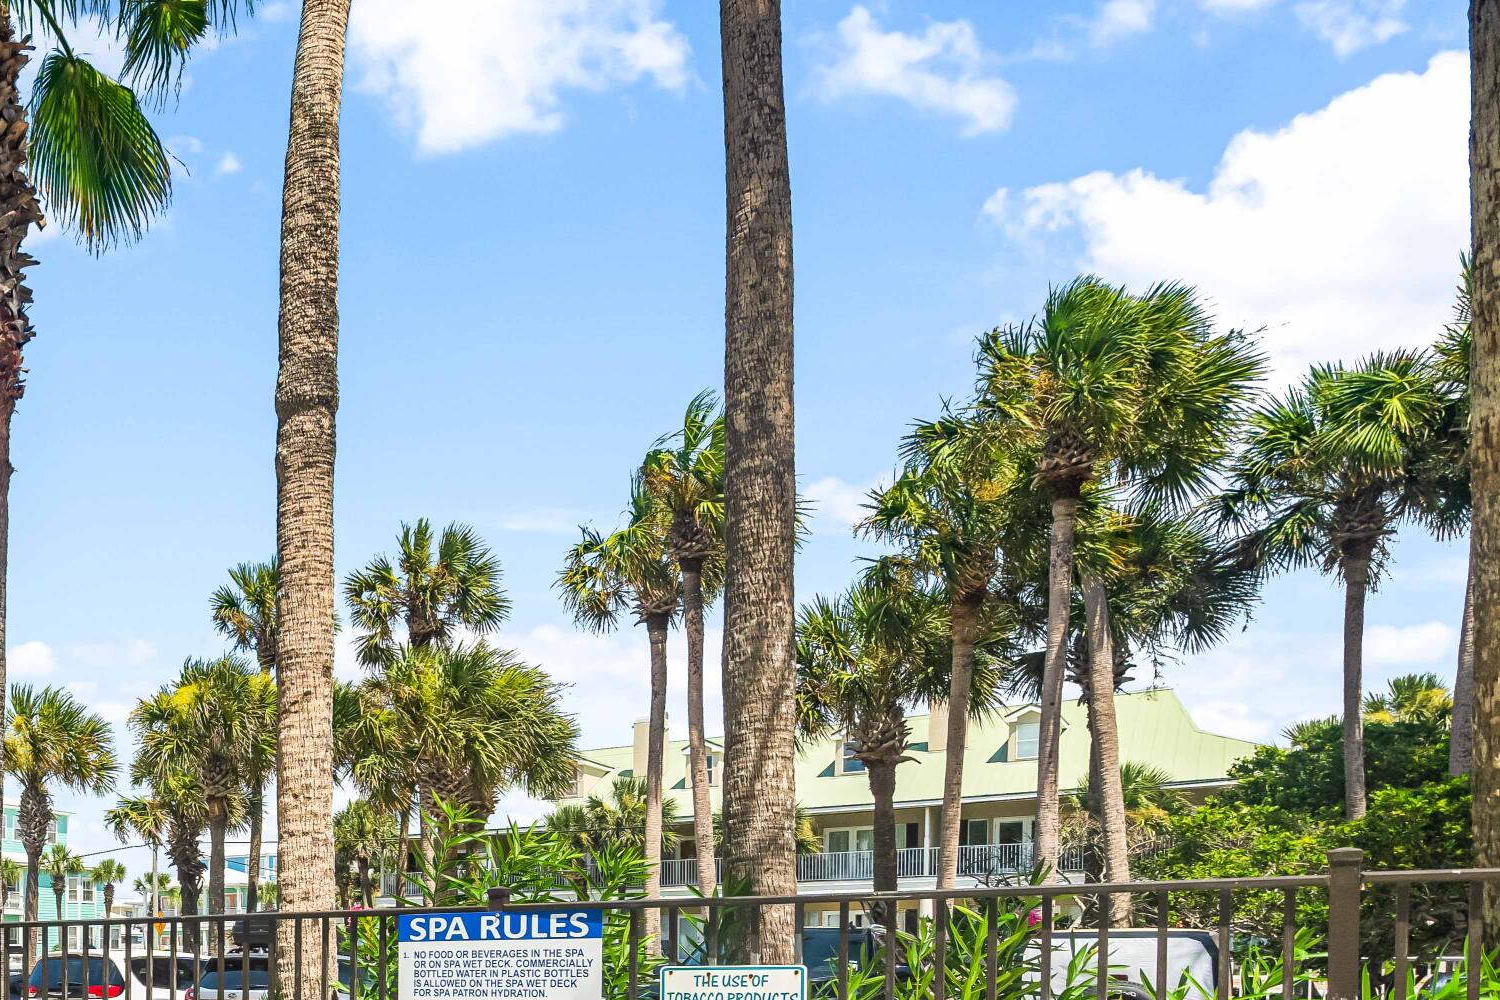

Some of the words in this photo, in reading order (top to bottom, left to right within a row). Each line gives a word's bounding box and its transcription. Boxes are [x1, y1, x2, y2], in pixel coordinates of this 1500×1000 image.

[410, 917, 469, 940] SPA
[481, 913, 589, 939] RULES
[414, 951, 426, 959] NO
[429, 950, 453, 959] FOOD
[456, 950, 469, 958] OR
[472, 950, 528, 958] BEVERAGES
[531, 949, 540, 957] IN
[543, 949, 562, 958] THE
[565, 949, 584, 957] SPA
[429, 960, 441, 968] ON
[444, 960, 461, 968] SPA
[463, 960, 482, 968] WET
[485, 960, 513, 968] DECK.
[516, 959, 593, 968] COMMERCIALLY
[414, 970, 454, 978] BOTTLED
[456, 970, 487, 978] WATER
[502, 969, 540, 978] PLASTIC
[544, 969, 589, 978] BOTTLES
[414, 979, 421, 987] IS
[423, 979, 466, 987] ALLOWED
[469, 979, 482, 987] ON
[485, 979, 503, 988] THE
[506, 979, 524, 987] SPA
[526, 979, 547, 988] WET
[550, 979, 577, 988] DECK
[694, 974, 718, 987] THE
[722, 975, 748, 987] USE
[752, 974, 769, 987] OF
[414, 988, 431, 997] FOR
[434, 989, 450, 997] SPA
[453, 989, 488, 997] PATRON
[491, 989, 548, 997] HYDRATION.
